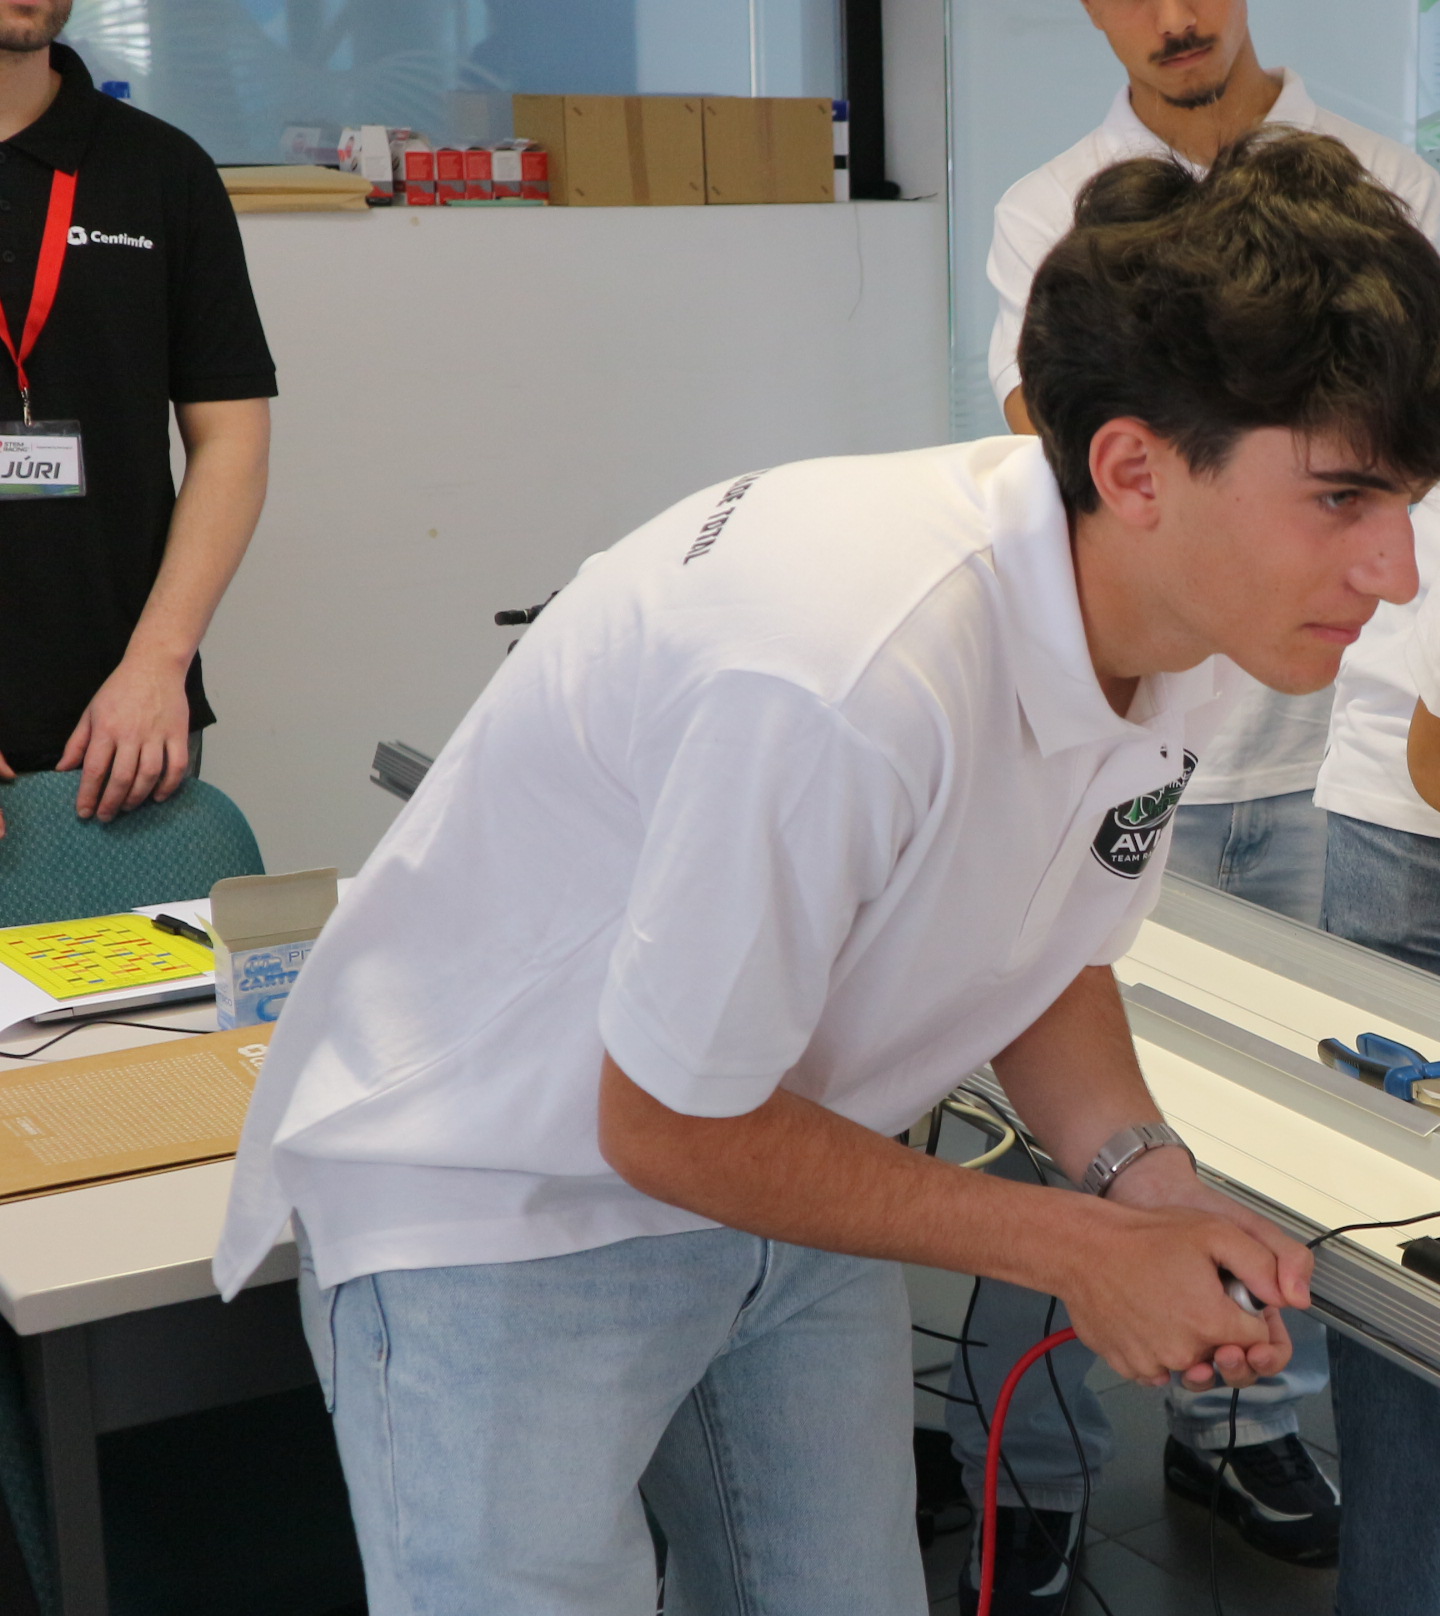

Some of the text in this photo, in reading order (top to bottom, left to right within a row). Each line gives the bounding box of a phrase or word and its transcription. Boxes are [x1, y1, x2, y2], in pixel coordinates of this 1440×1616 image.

[90, 230, 153, 249] Centimfe
[1, 456, 61, 479] JÚRI
[683, 507, 735, 565] TOTAL
[1110, 828, 1162, 853] AVI
[1111, 853, 1140, 862] TEAM
